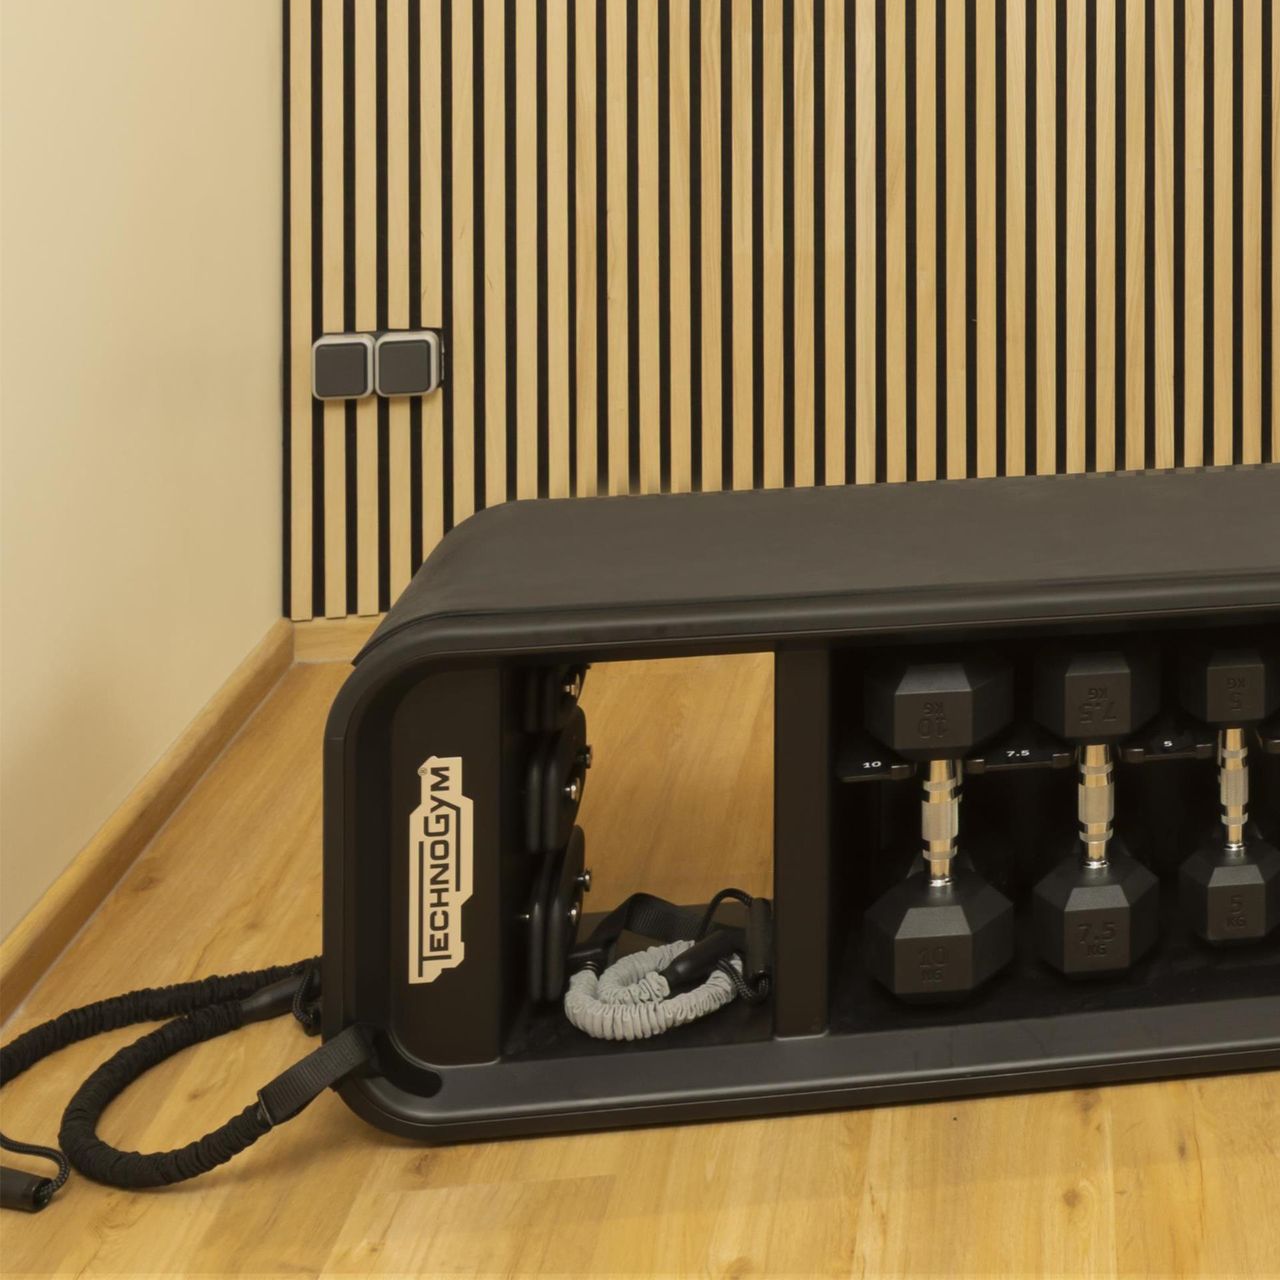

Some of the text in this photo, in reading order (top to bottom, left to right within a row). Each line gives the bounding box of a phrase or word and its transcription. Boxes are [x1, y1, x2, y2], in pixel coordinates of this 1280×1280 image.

[1226, 677, 1246, 690] KG
[1088, 687, 1107, 700] KG
[923, 702, 943, 716] KG
[1163, 740, 1172, 748] 5
[1006, 749, 1030, 758] 7.5
[862, 760, 882, 769] 10
[418, 766, 461, 978] TECHNOGYM
[1231, 895, 1243, 915] 5
[1077, 923, 1117, 944] 7.5
[1087, 945, 1107, 958] KG
